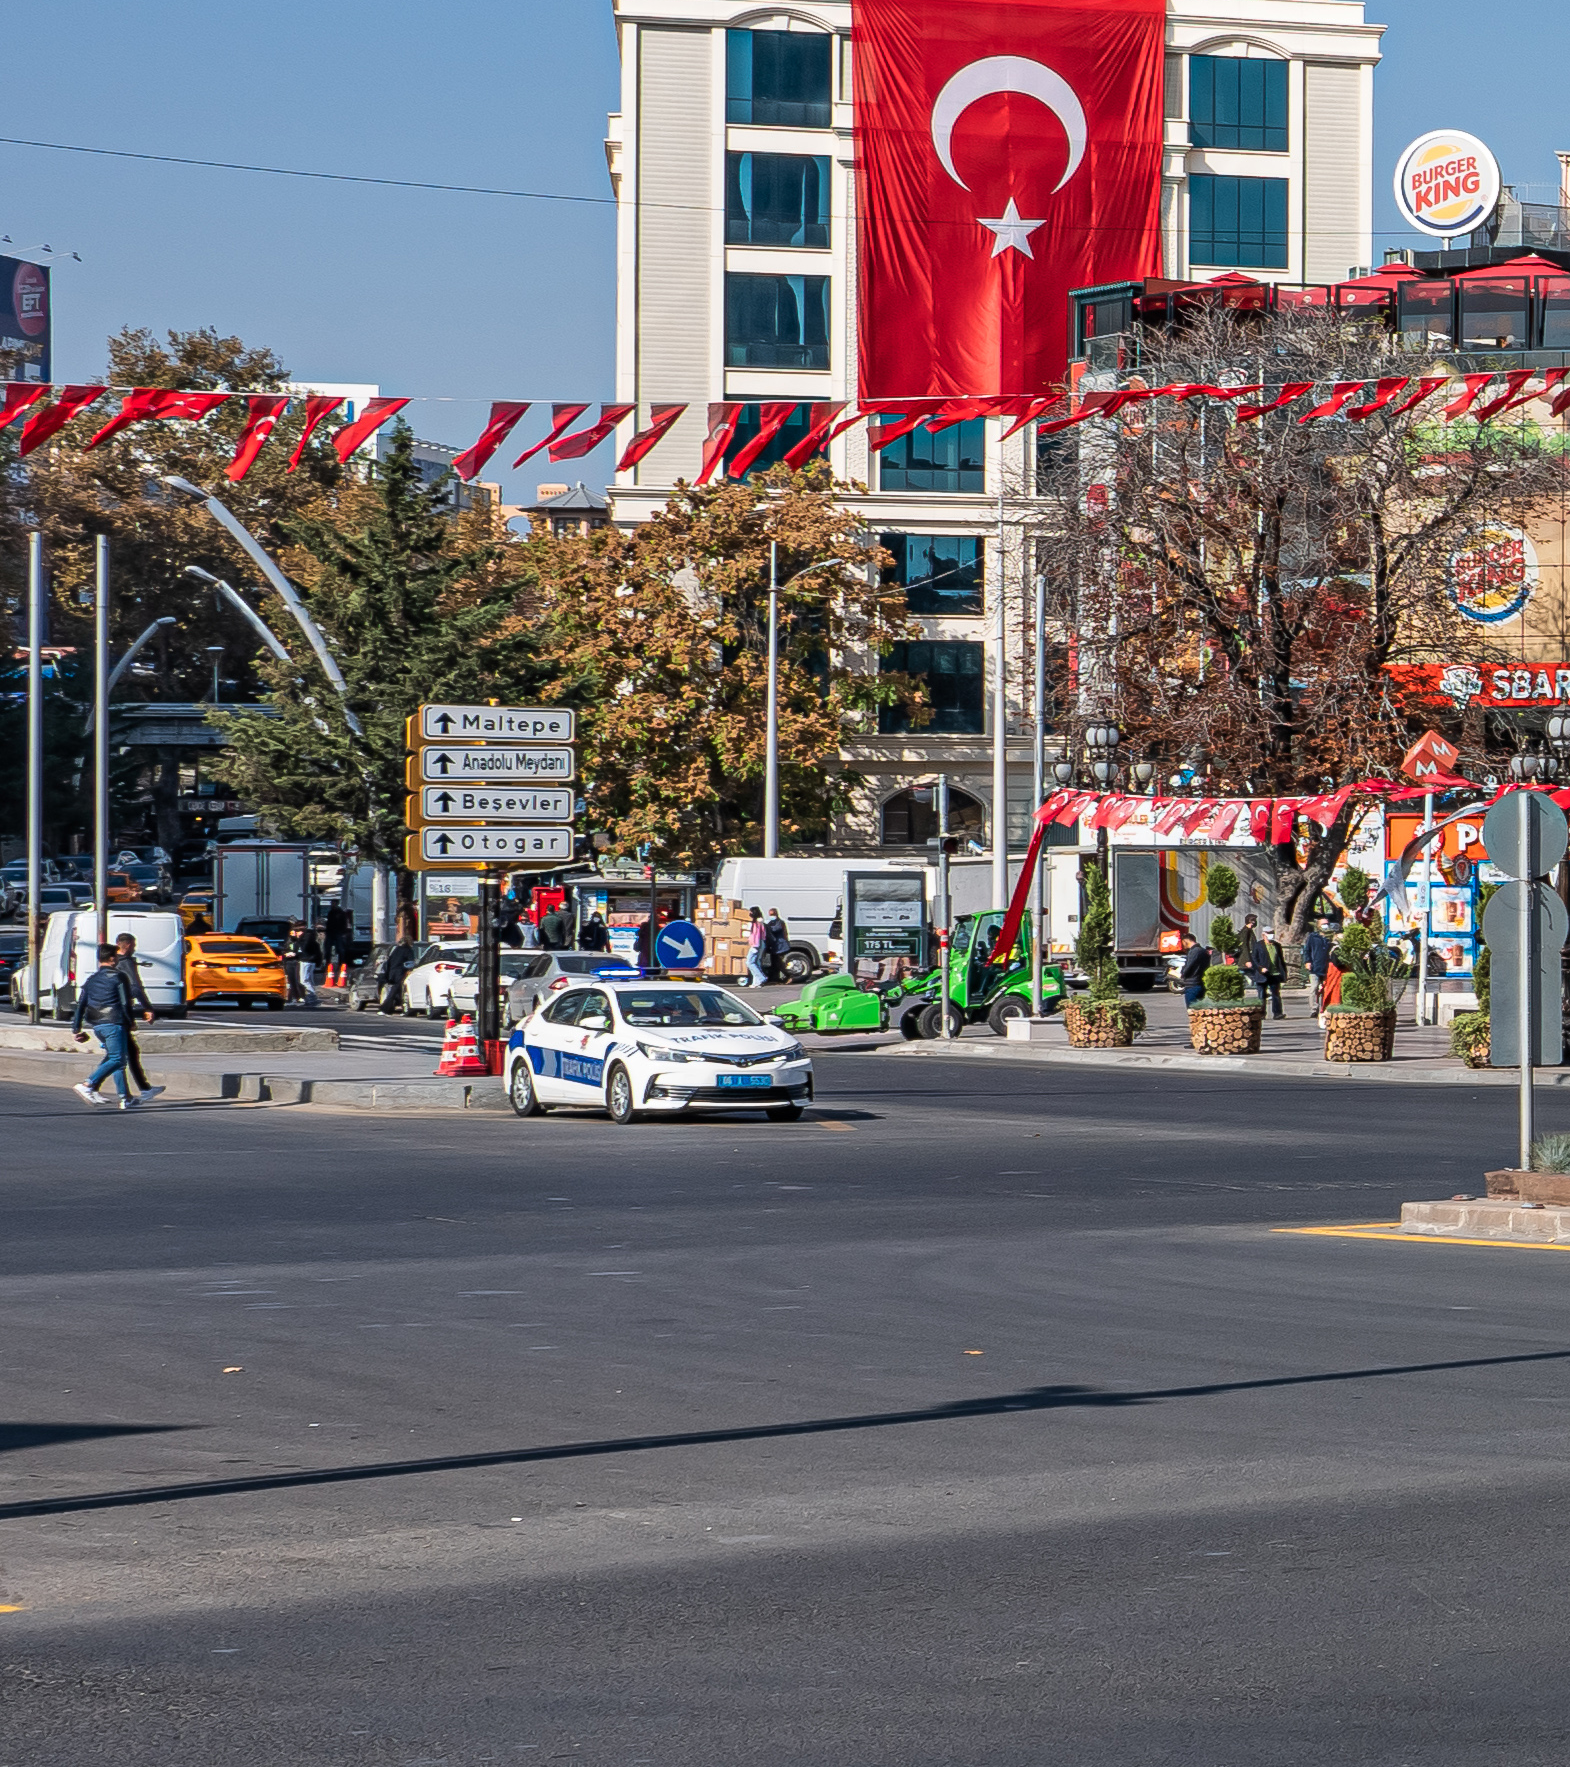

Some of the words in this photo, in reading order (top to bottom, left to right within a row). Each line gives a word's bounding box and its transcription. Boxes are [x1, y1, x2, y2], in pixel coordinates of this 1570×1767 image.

[1411, 155, 1477, 190] BURGER
[1415, 171, 1480, 214] KING
[462, 714, 561, 736] Maltepe
[1431, 740, 1451, 756] M
[462, 753, 512, 770] Anadolu
[515, 753, 566, 775] Meydanı
[1416, 760, 1437, 776] M
[462, 793, 562, 812] Beşevler
[461, 834, 559, 853] Otogar
[864, 940, 881, 949] 175
